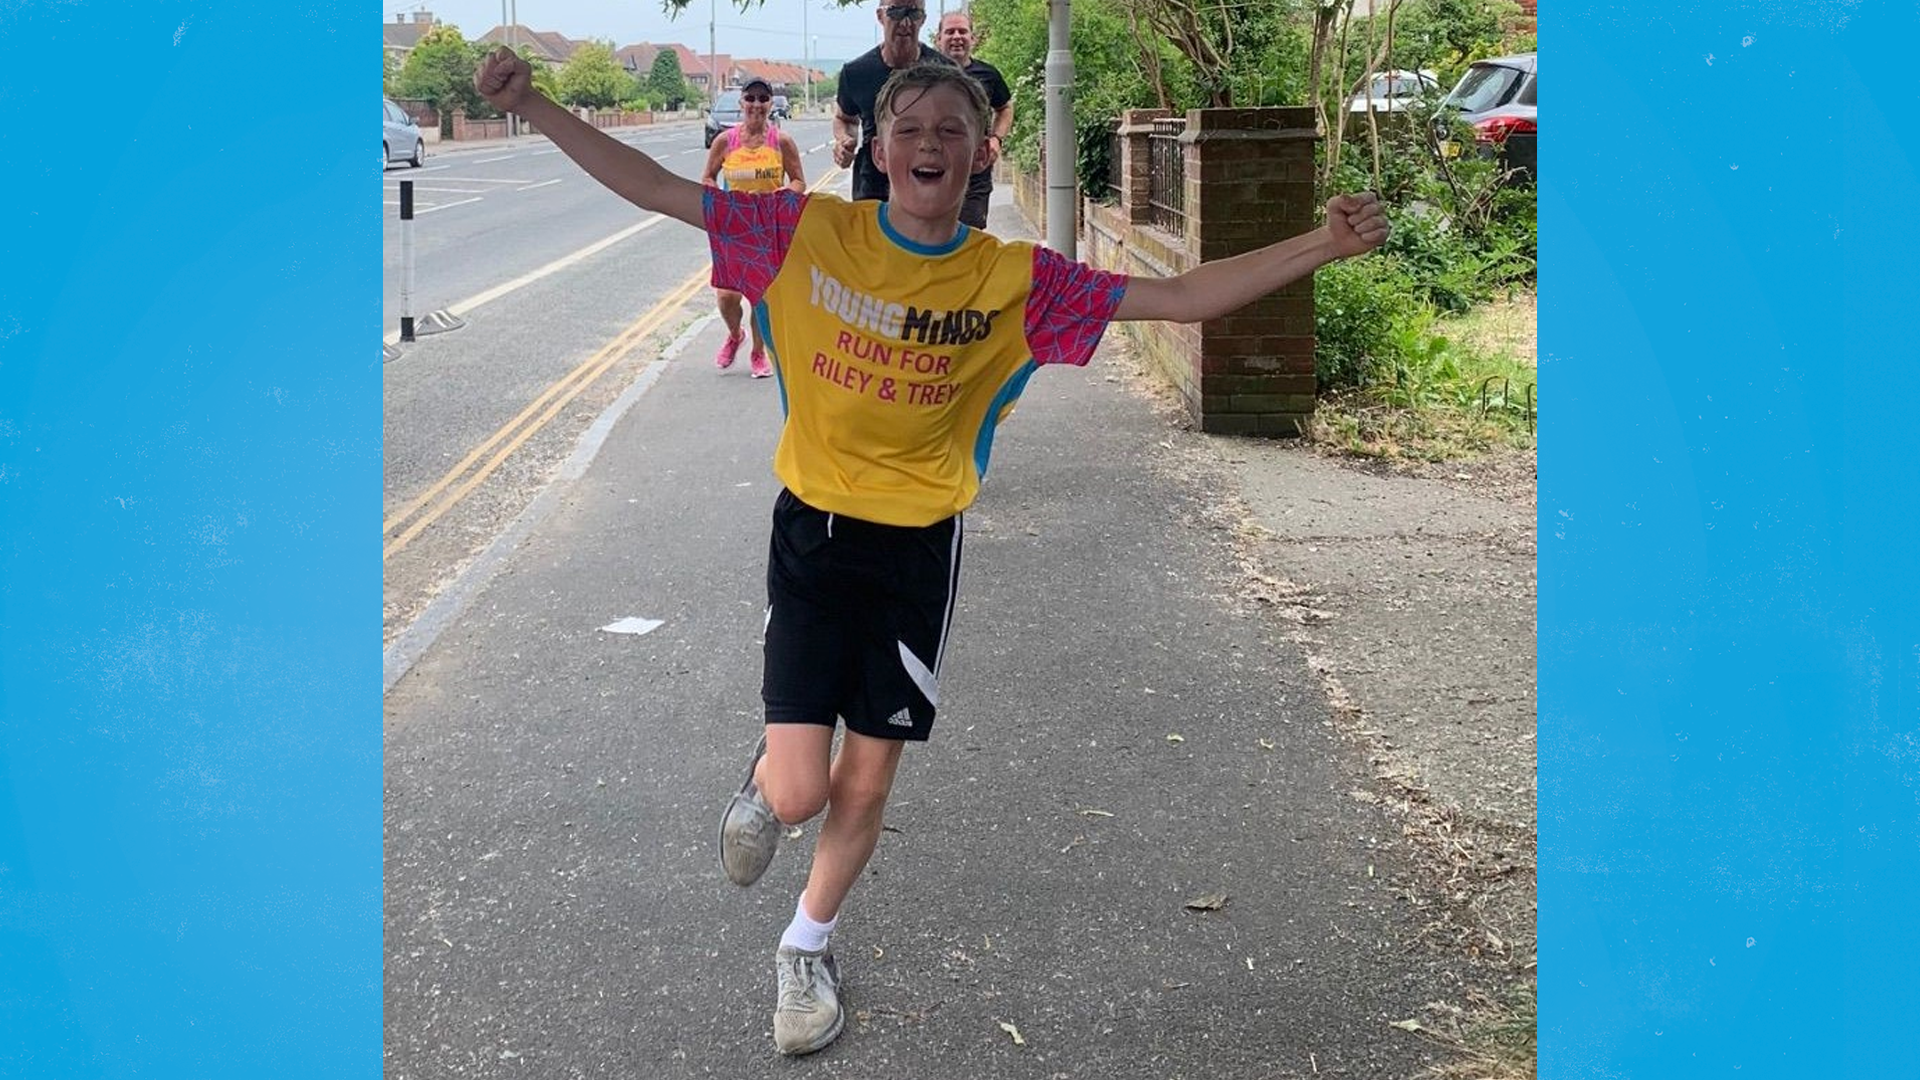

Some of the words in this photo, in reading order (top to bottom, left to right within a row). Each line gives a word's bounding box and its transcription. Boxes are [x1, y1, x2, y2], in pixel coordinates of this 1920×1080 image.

[837, 330, 892, 365] RUN
[900, 351, 951, 375] FOR
[812, 352, 873, 394] RILEY
[878, 378, 897, 403] &
[908, 382, 962, 405] TREY
